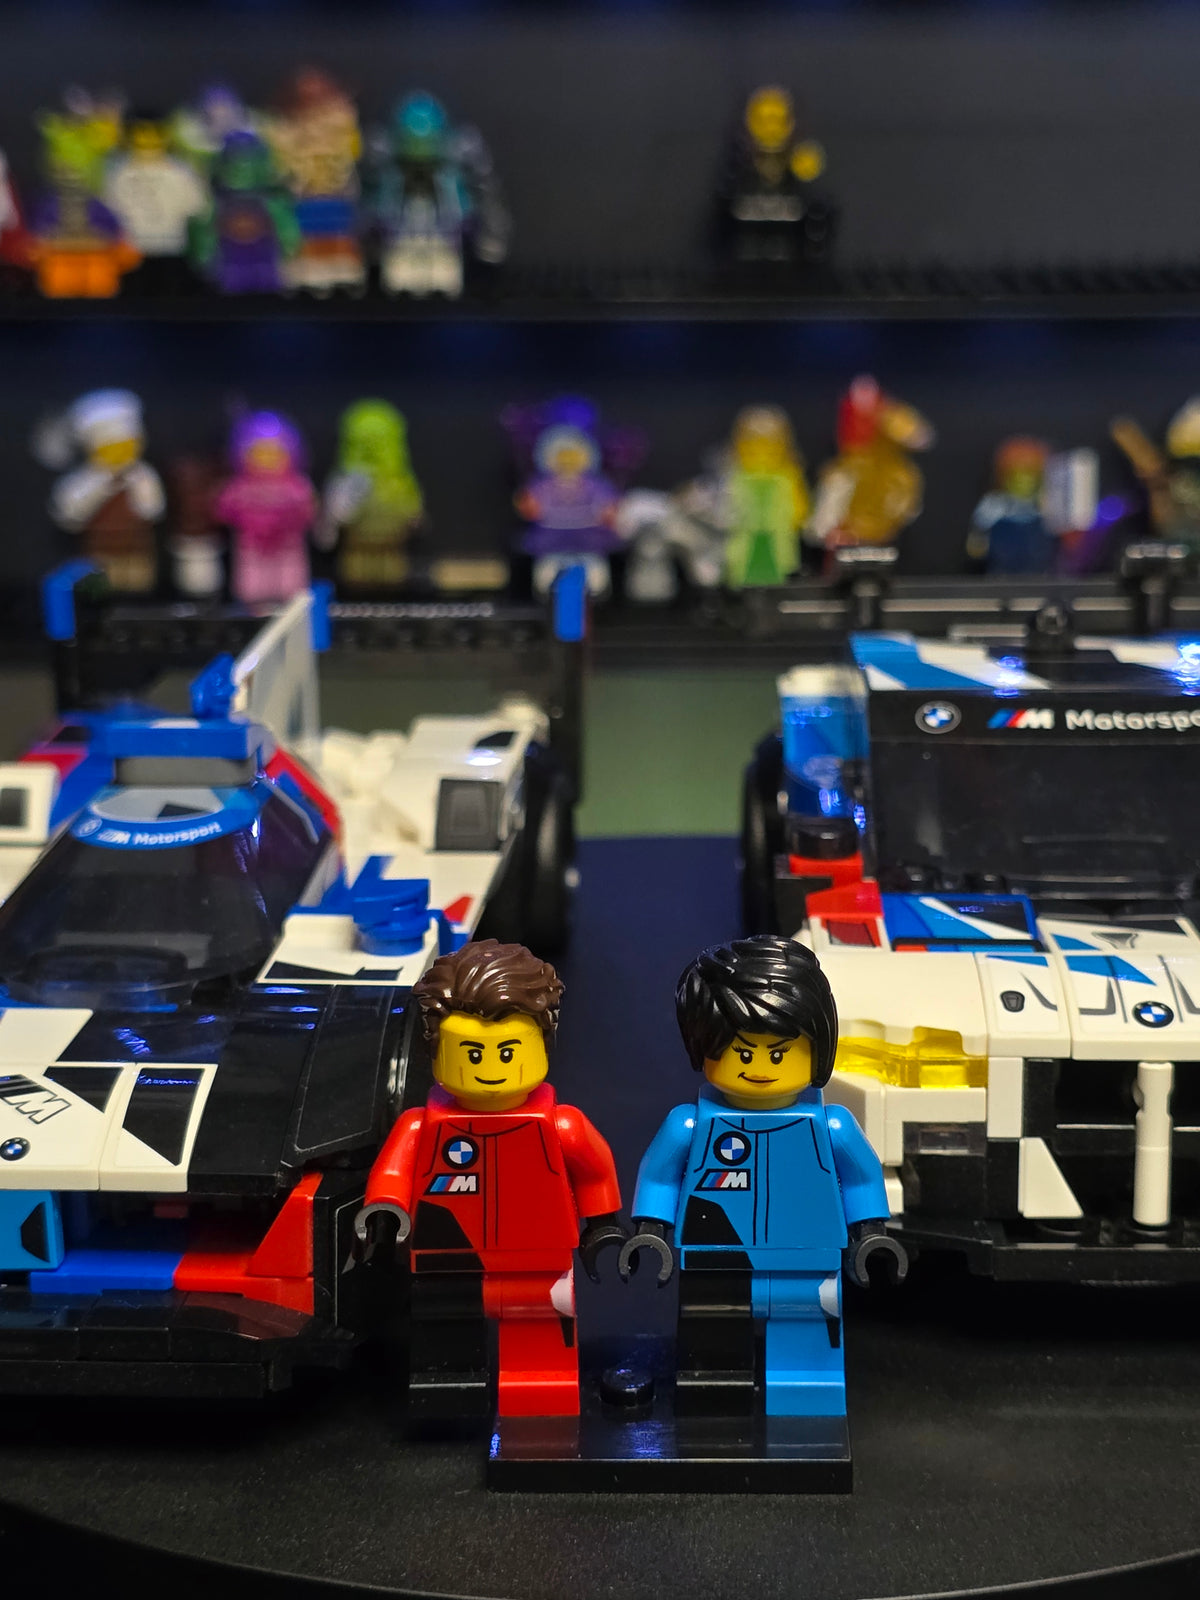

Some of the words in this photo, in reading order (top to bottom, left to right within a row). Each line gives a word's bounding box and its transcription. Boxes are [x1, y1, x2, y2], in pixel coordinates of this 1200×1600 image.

[133, 821, 222, 845] Motorsport
[448, 1175, 477, 1192] M
[720, 1171, 748, 1188] M
